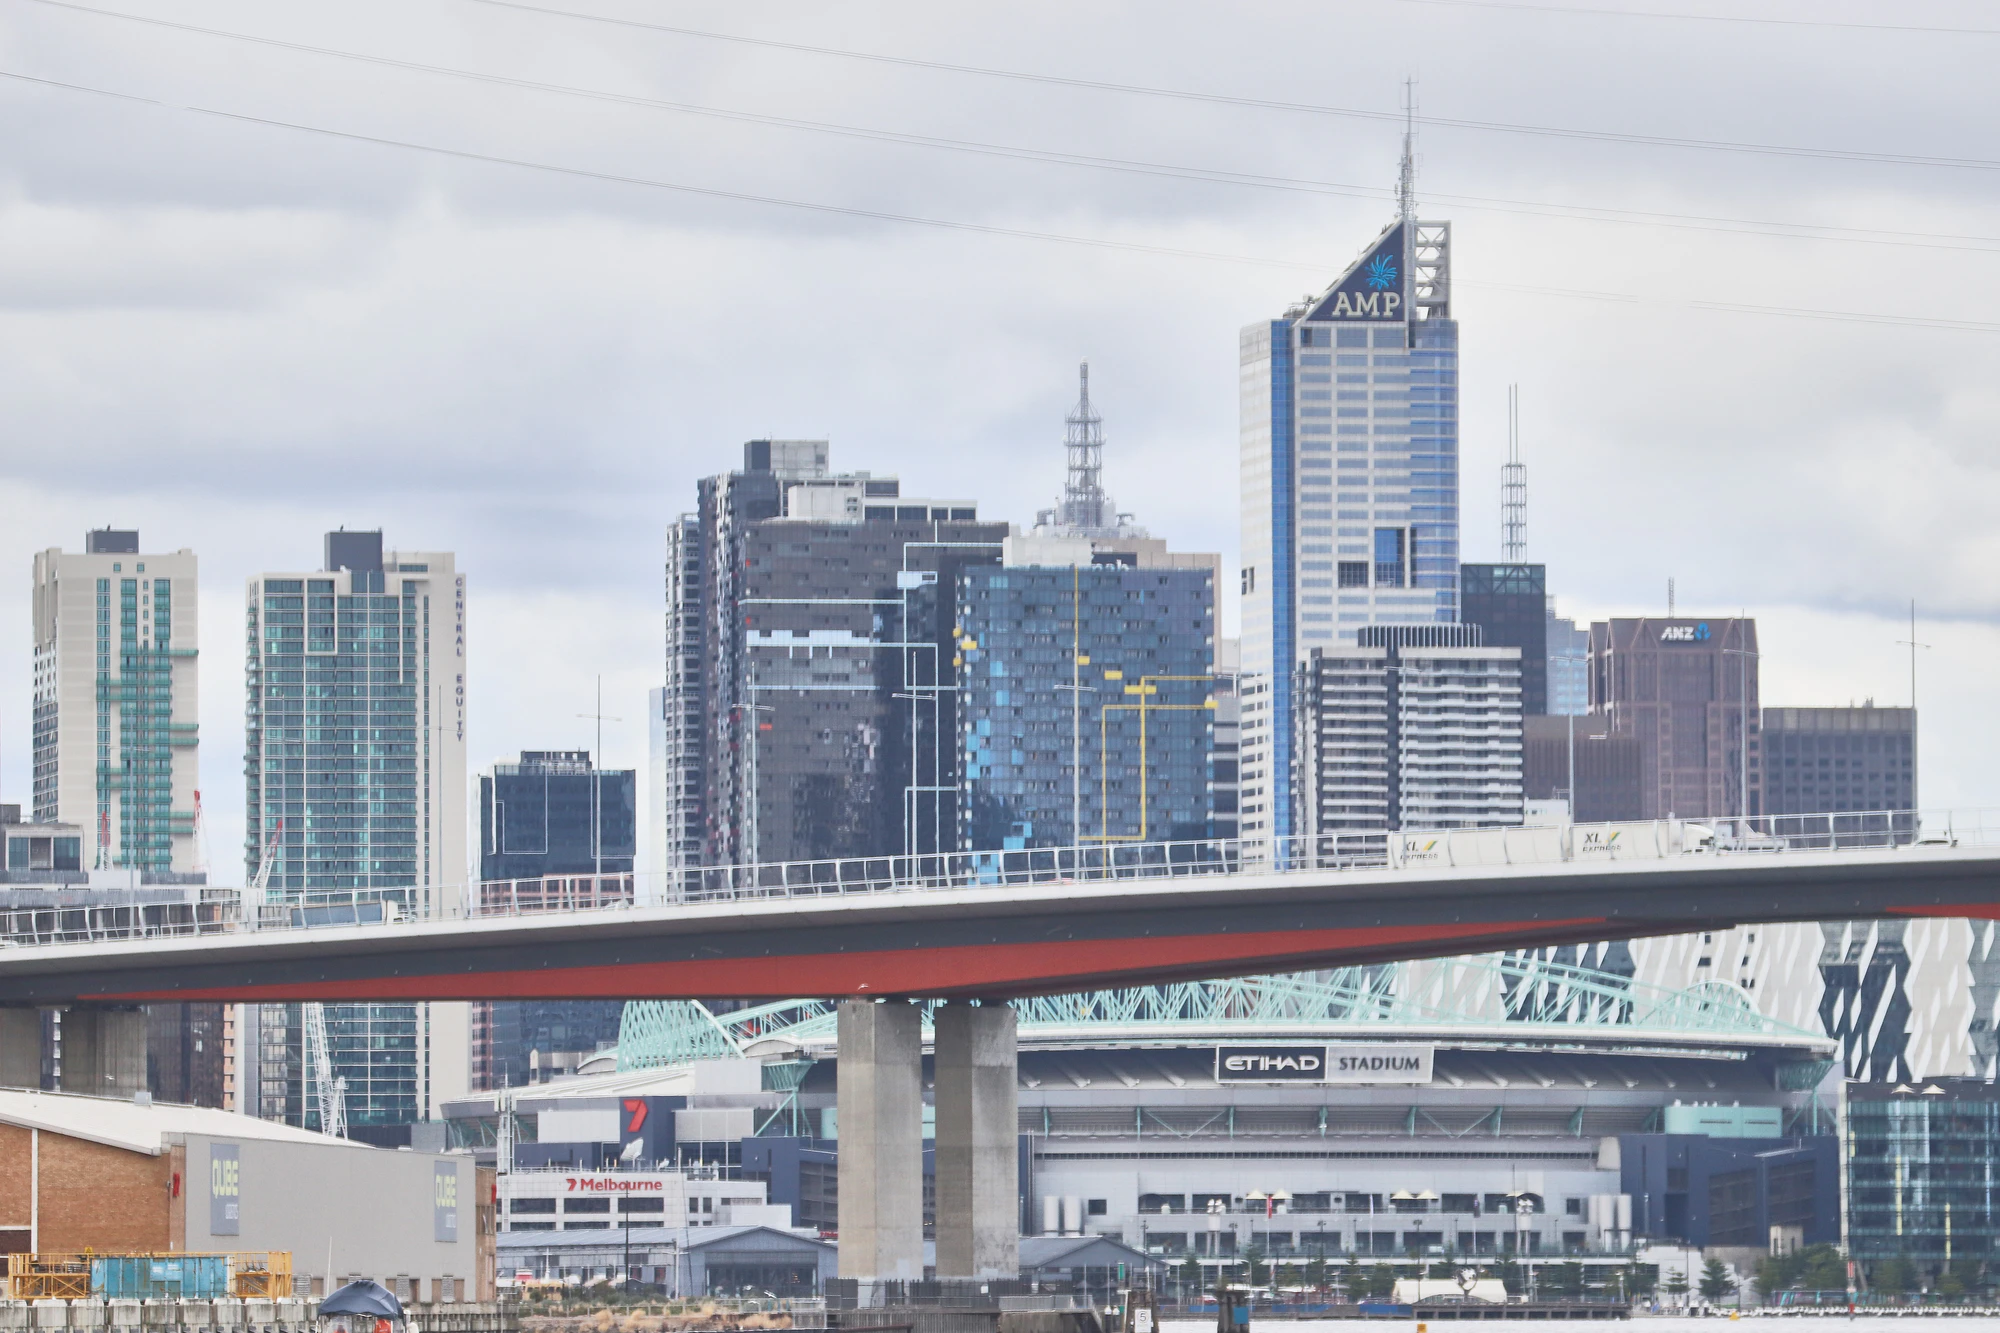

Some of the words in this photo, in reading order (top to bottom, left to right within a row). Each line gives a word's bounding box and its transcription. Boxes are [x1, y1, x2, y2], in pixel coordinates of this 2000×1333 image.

[1331, 292, 1400, 317] AMP
[1661, 626, 1694, 640] ANZ
[1225, 1056, 1320, 1071] ETIHAD
[1339, 1057, 1420, 1071] STADIUM
[623, 1100, 648, 1132] 7
[212, 1159, 238, 1199] QUBE
[566, 1179, 577, 1191] 7
[580, 1178, 662, 1191] Melbourne
[436, 1175, 456, 1208] QUBE
[1140, 1312, 1147, 1321] 5
